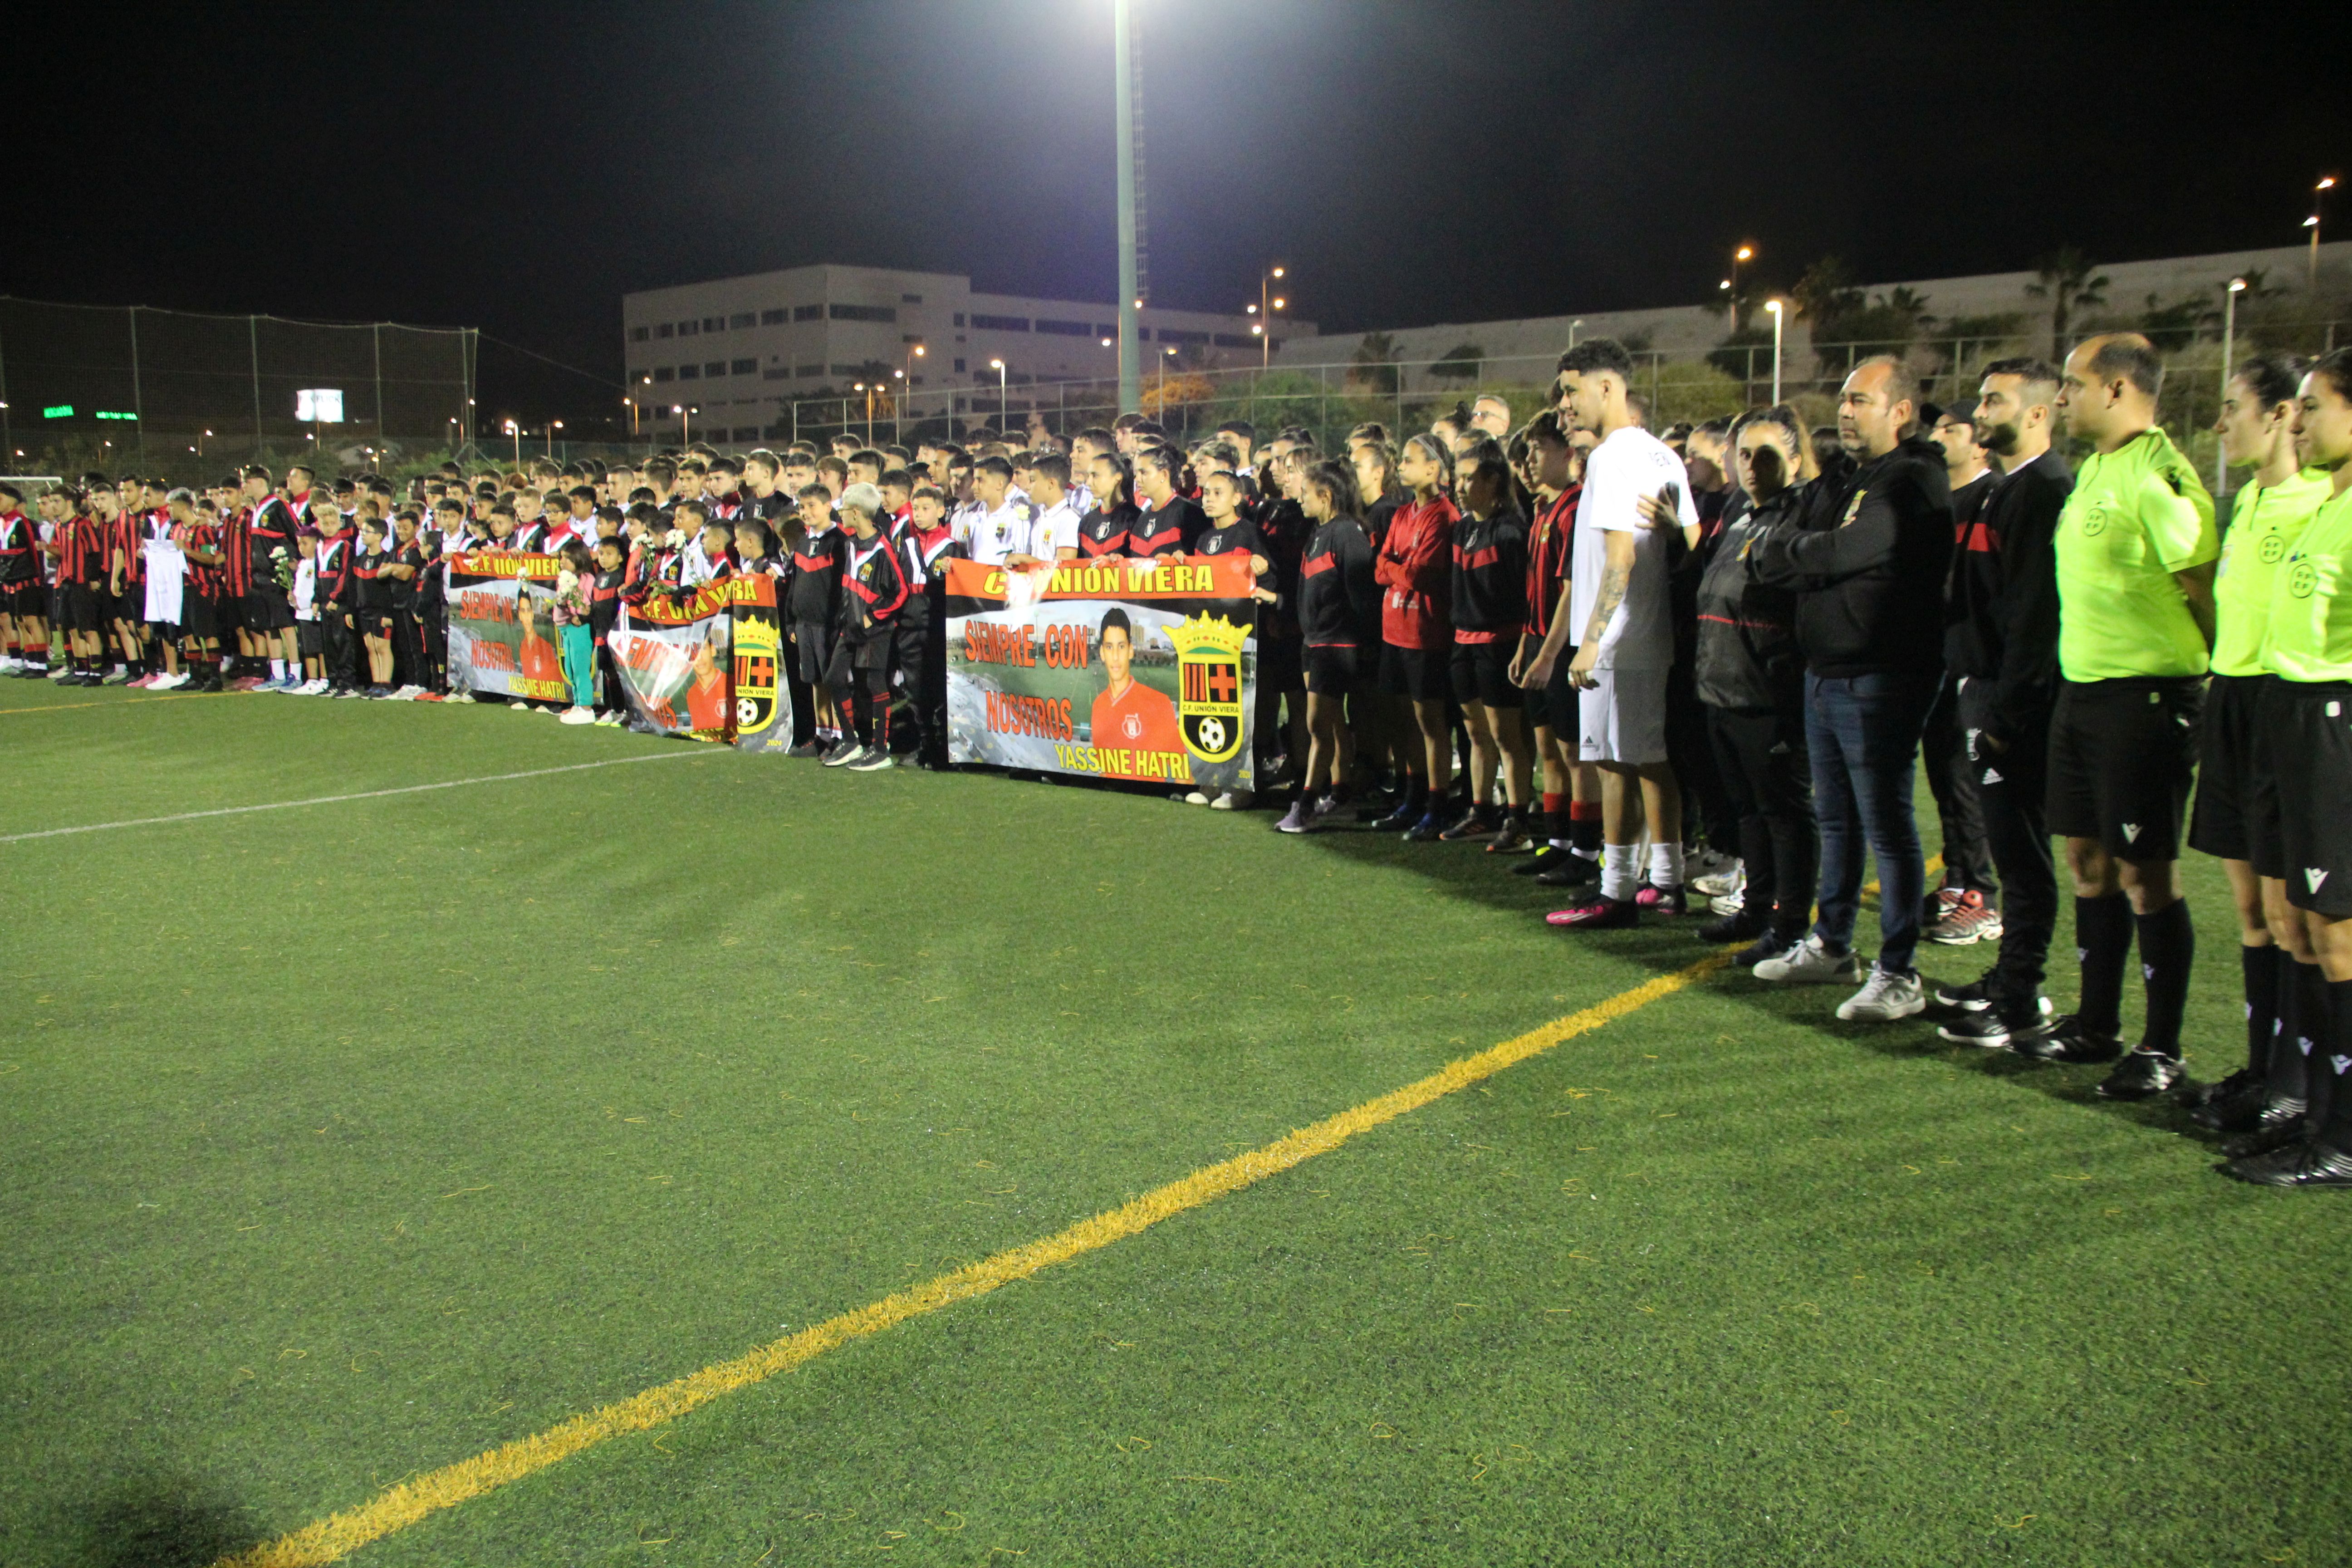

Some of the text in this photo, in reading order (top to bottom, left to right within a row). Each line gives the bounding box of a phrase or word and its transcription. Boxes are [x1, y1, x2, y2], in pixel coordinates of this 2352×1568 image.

[524, 559, 561, 576] VIER
[1127, 564, 1214, 592] VIERA
[965, 619, 1088, 669] SIEMPRE CON
[508, 675, 567, 699] YASSINE HATRI
[985, 690, 1073, 742] NOSOTROS
[1194, 704, 1217, 712] UNIÓN
[1054, 744, 1191, 780] YASSINE HATRI
